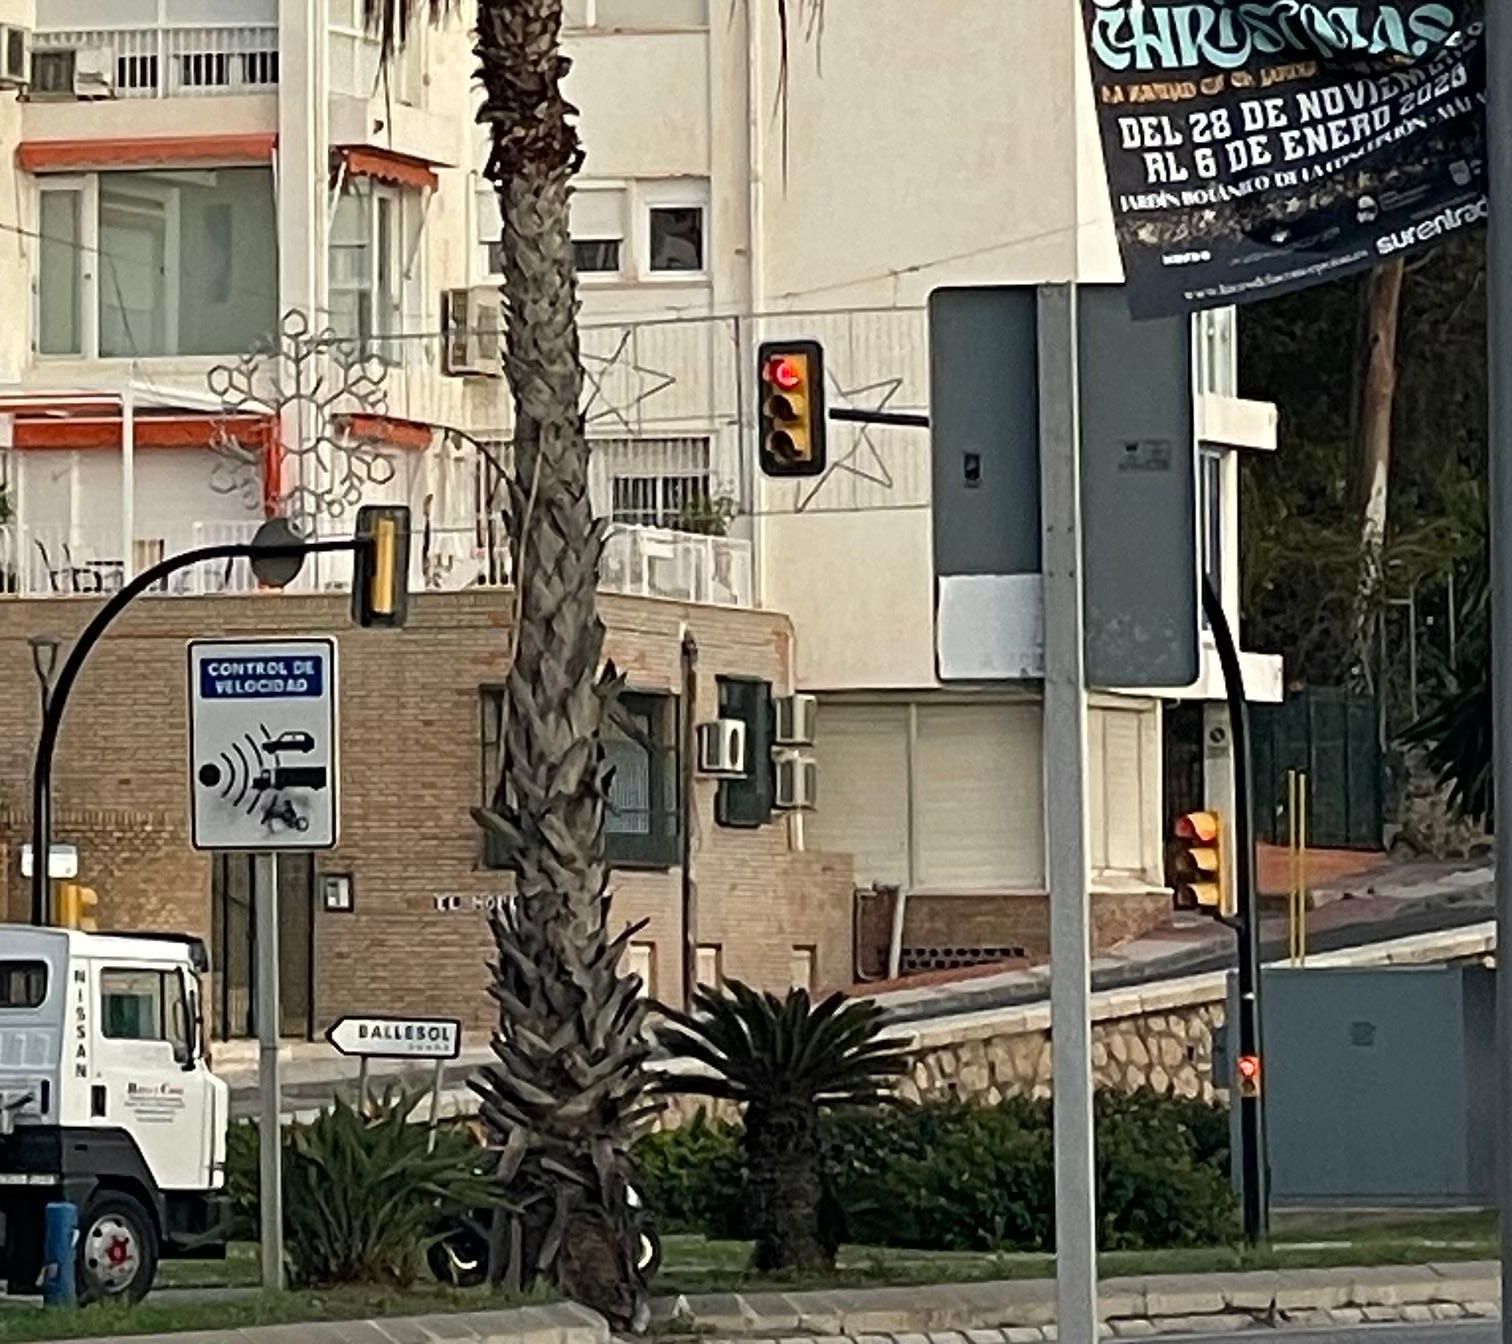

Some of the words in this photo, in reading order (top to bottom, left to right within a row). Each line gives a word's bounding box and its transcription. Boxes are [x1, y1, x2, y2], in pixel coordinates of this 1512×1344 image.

[1118, 116, 1183, 149] DEL
[1189, 108, 1232, 143] 28
[1240, 98, 1288, 132] DE
[1143, 151, 1188, 183] AL
[1194, 148, 1217, 179] 6
[1225, 135, 1272, 173] DE
[1280, 104, 1390, 161] ENERO
[207, 662, 288, 676] CONTROL
[293, 660, 315, 675] DE
[215, 678, 308, 694] VELOCIDAD
[74, 970, 88, 1078] NISSAN
[359, 1024, 450, 1042] BALLESOL
